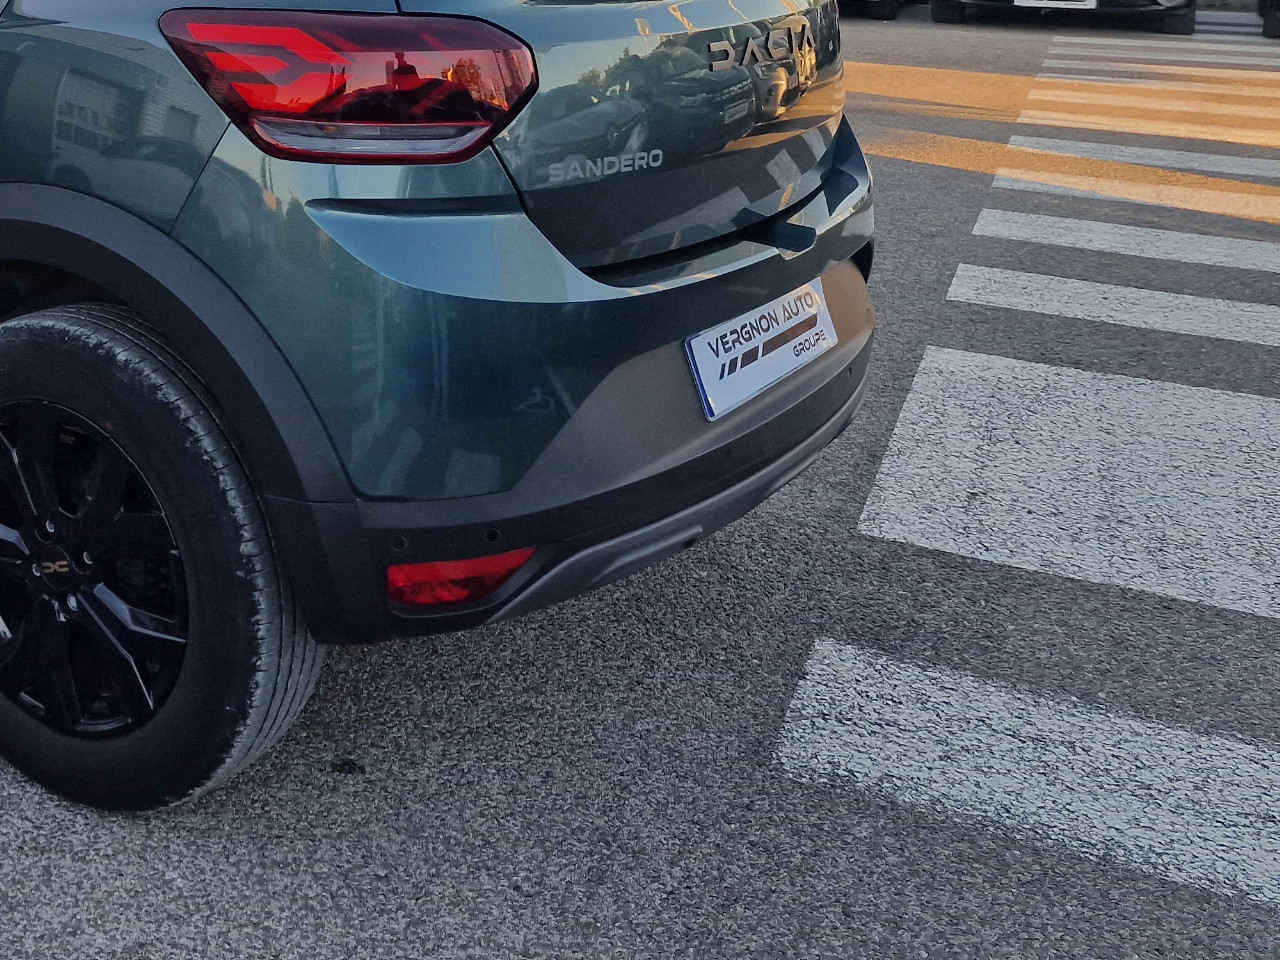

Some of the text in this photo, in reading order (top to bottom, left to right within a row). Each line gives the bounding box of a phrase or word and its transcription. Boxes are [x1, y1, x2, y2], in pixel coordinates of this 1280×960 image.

[548, 149, 663, 182] SANDERO
[707, 290, 815, 359] VERGNON AUTO
[792, 329, 826, 358] GROUPE
